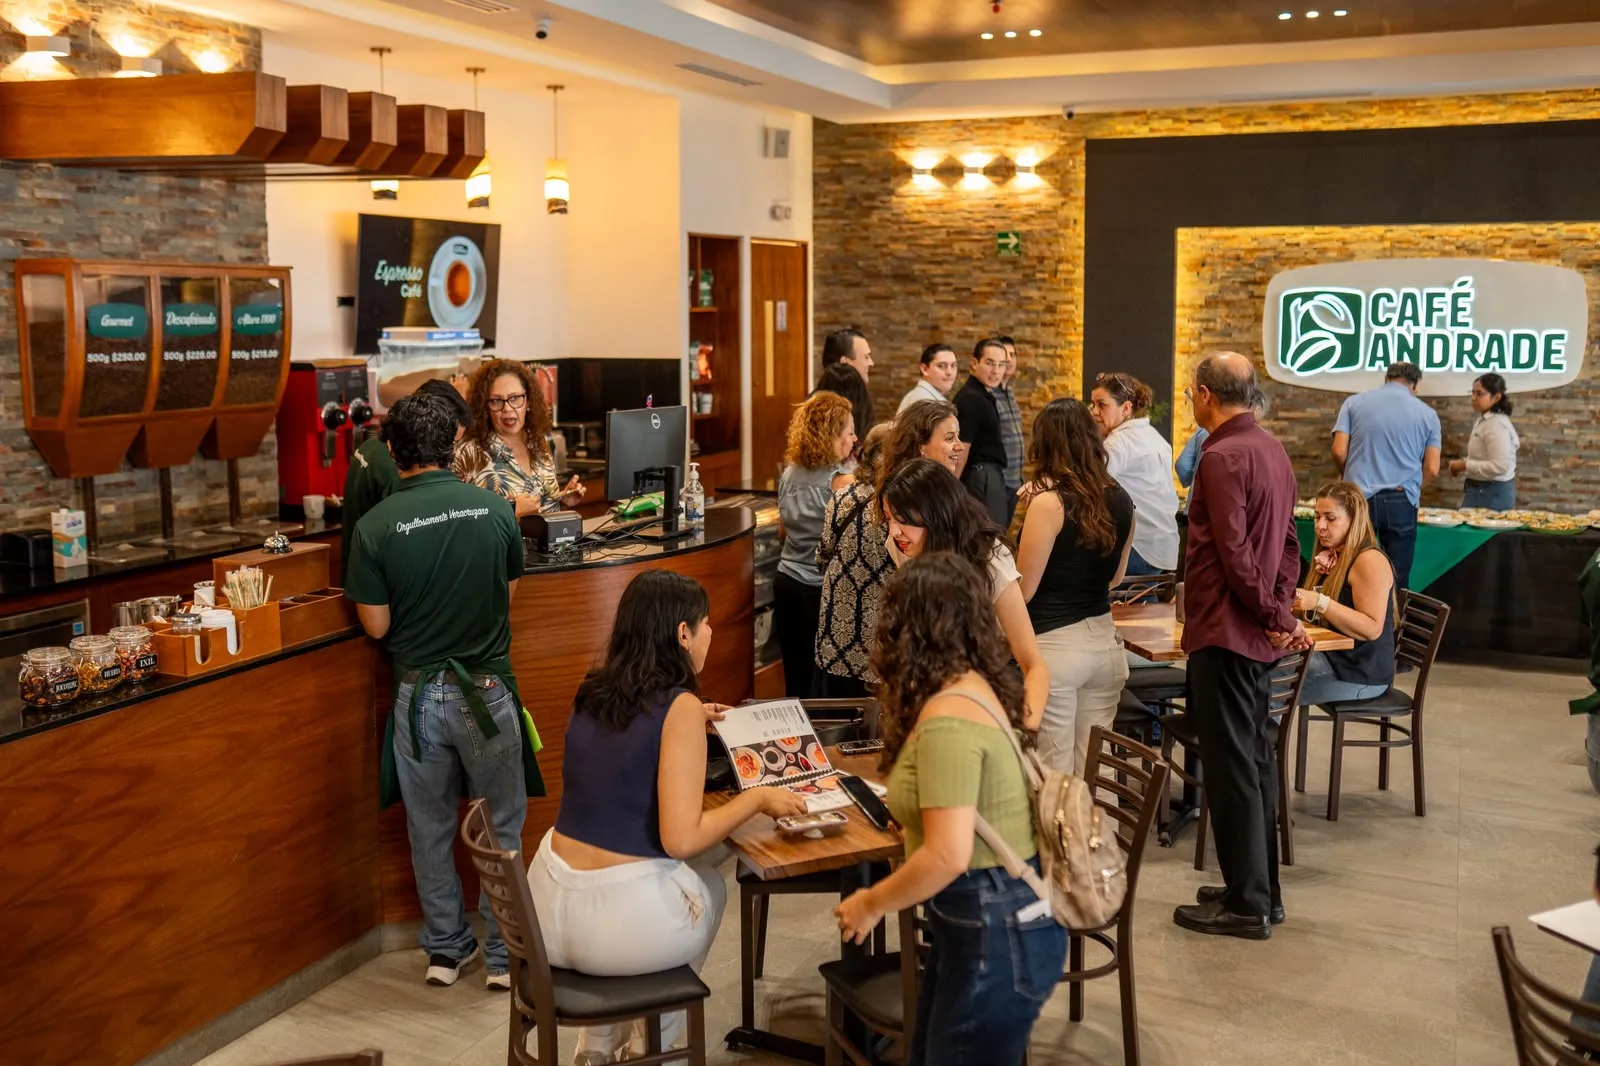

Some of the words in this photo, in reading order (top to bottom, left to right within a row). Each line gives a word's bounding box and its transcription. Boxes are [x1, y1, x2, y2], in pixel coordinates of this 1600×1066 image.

[374, 260, 423, 286] Espresso
[400, 283, 422, 298] Café
[1369, 277, 1474, 329] CAFÉ
[101, 314, 134, 327] Gourmet
[87, 352, 110, 364] 500g
[163, 350, 185, 362] 500g
[1366, 329, 1568, 373] ANDRADE
[396, 511, 449, 535] Orgullosamente
[448, 507, 489, 520] Veracruzano
